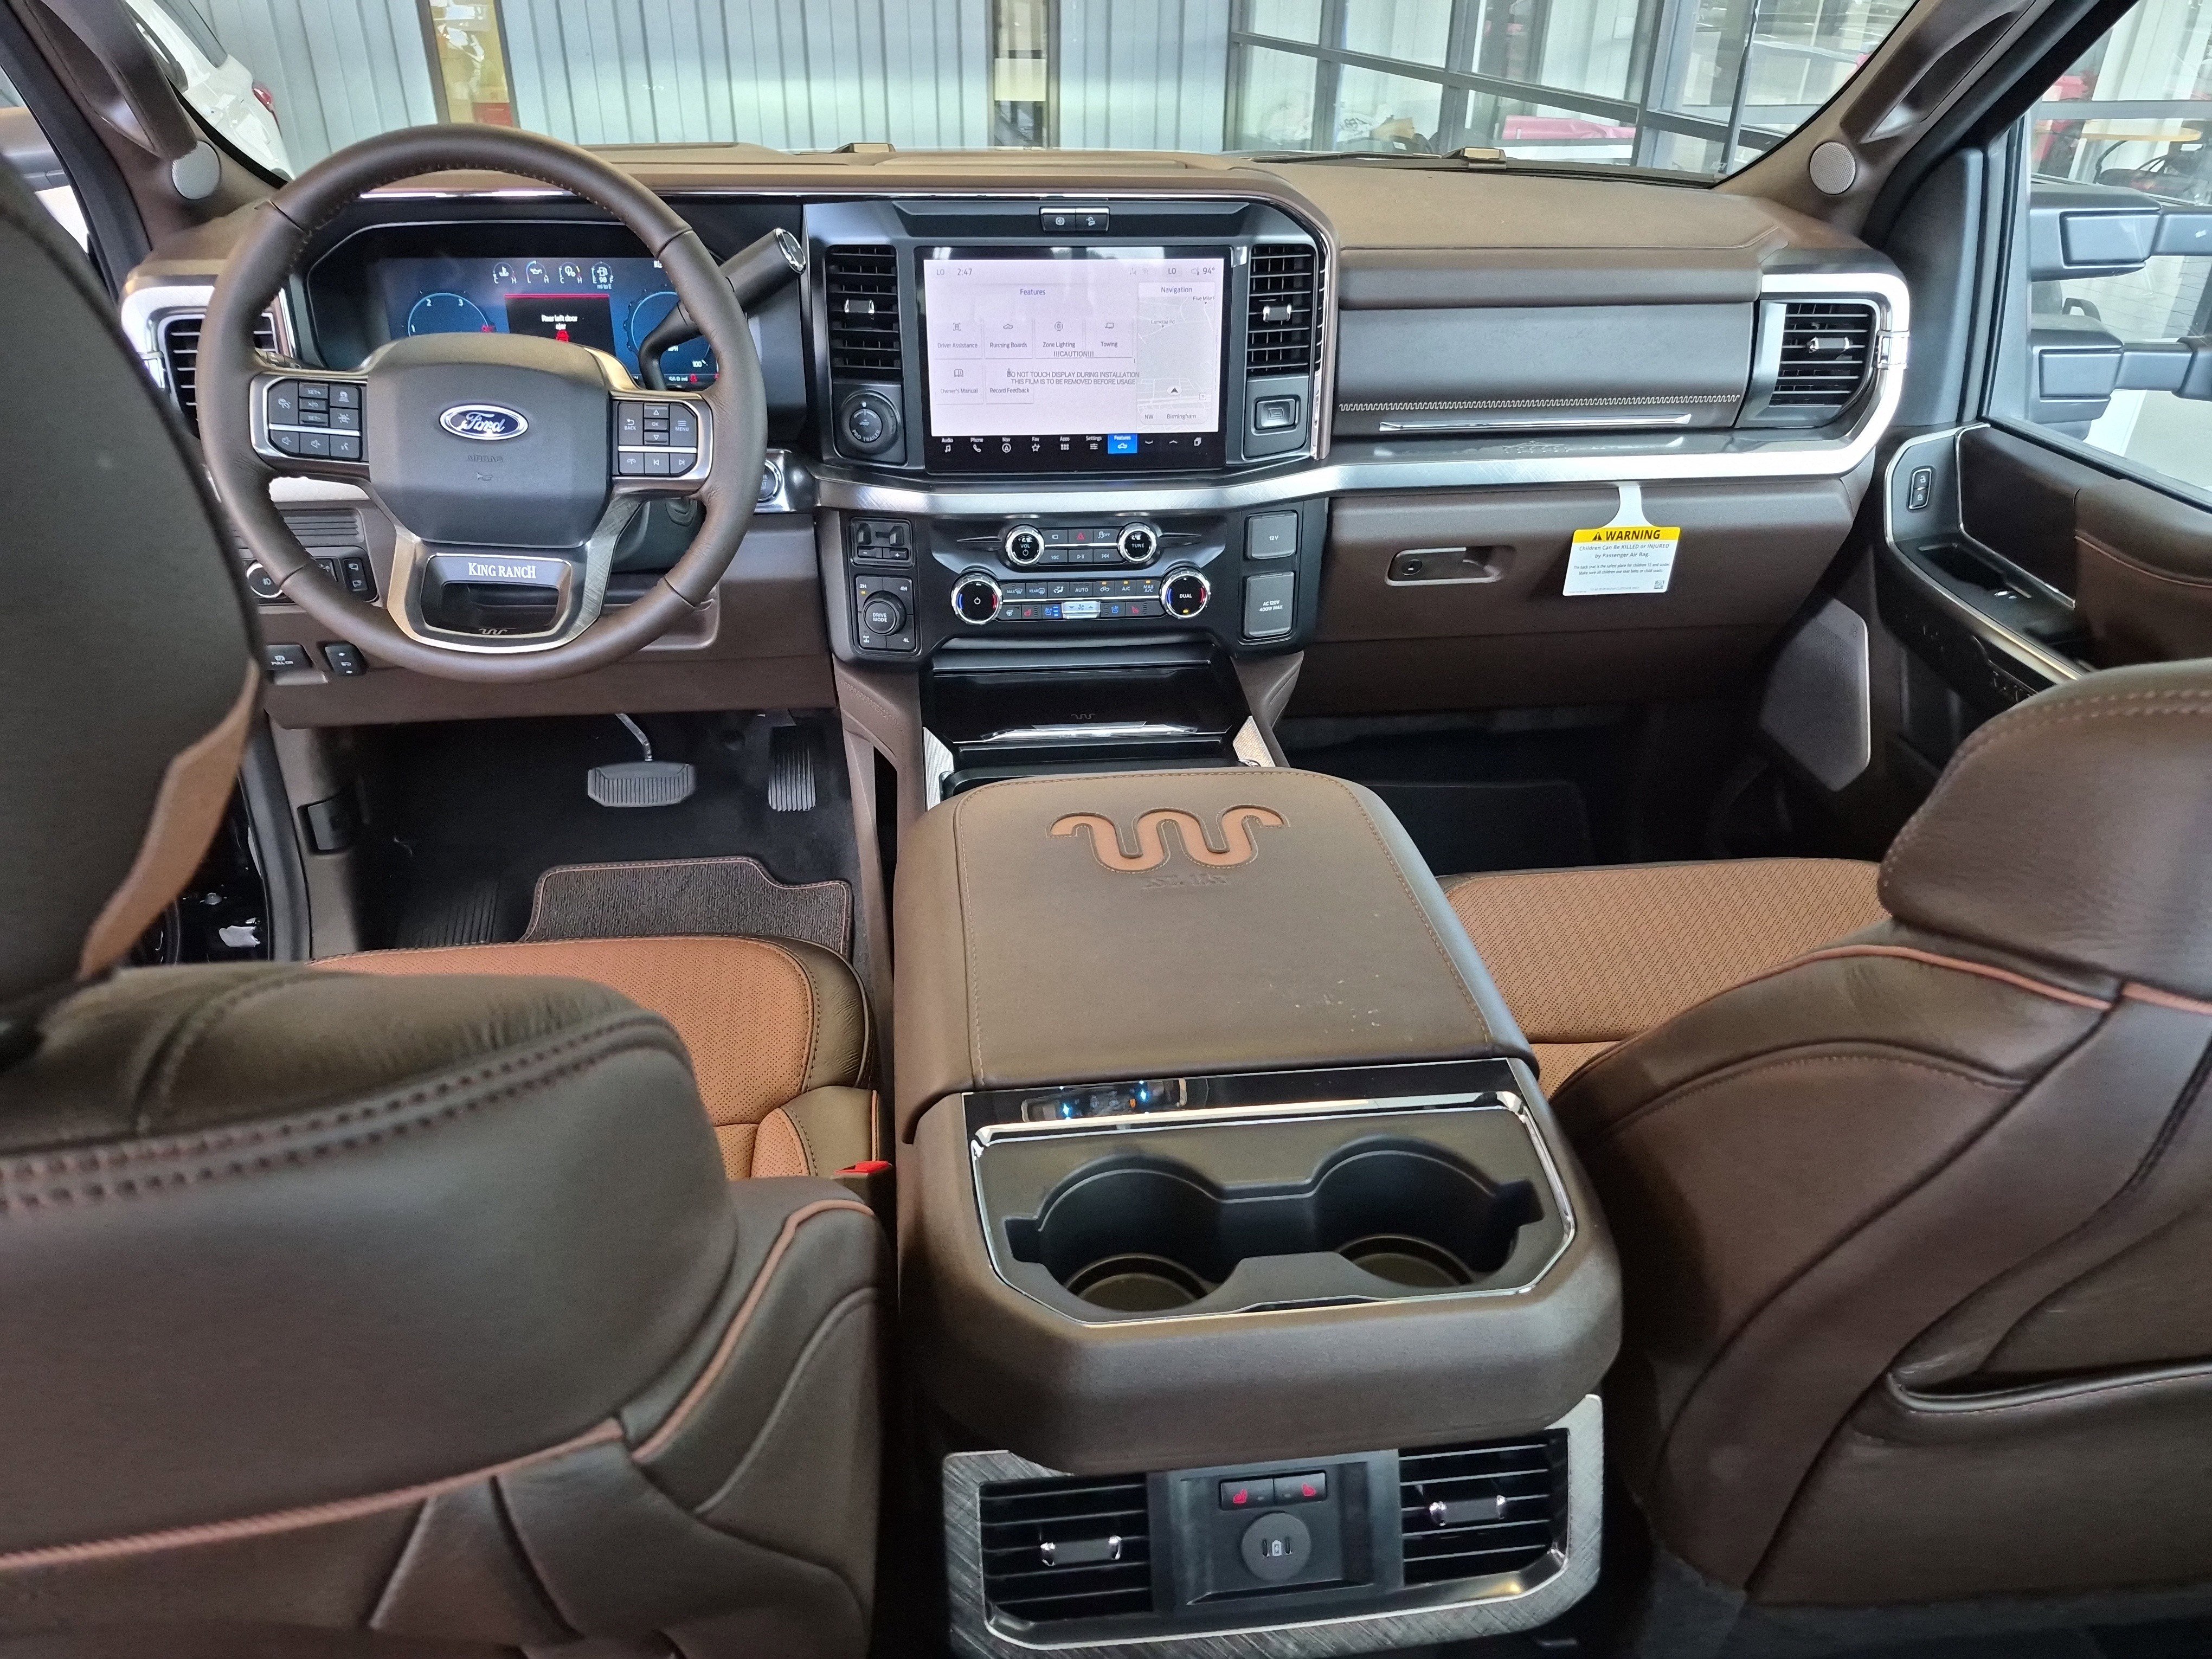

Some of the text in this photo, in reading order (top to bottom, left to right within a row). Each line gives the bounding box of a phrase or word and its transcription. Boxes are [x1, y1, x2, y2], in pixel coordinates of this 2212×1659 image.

[461, 411, 505, 433] Ford
[852, 429, 880, 442] PRO TRAILER
[1605, 530, 1661, 541] WARNING
[468, 562, 536, 578] KING RANCH
